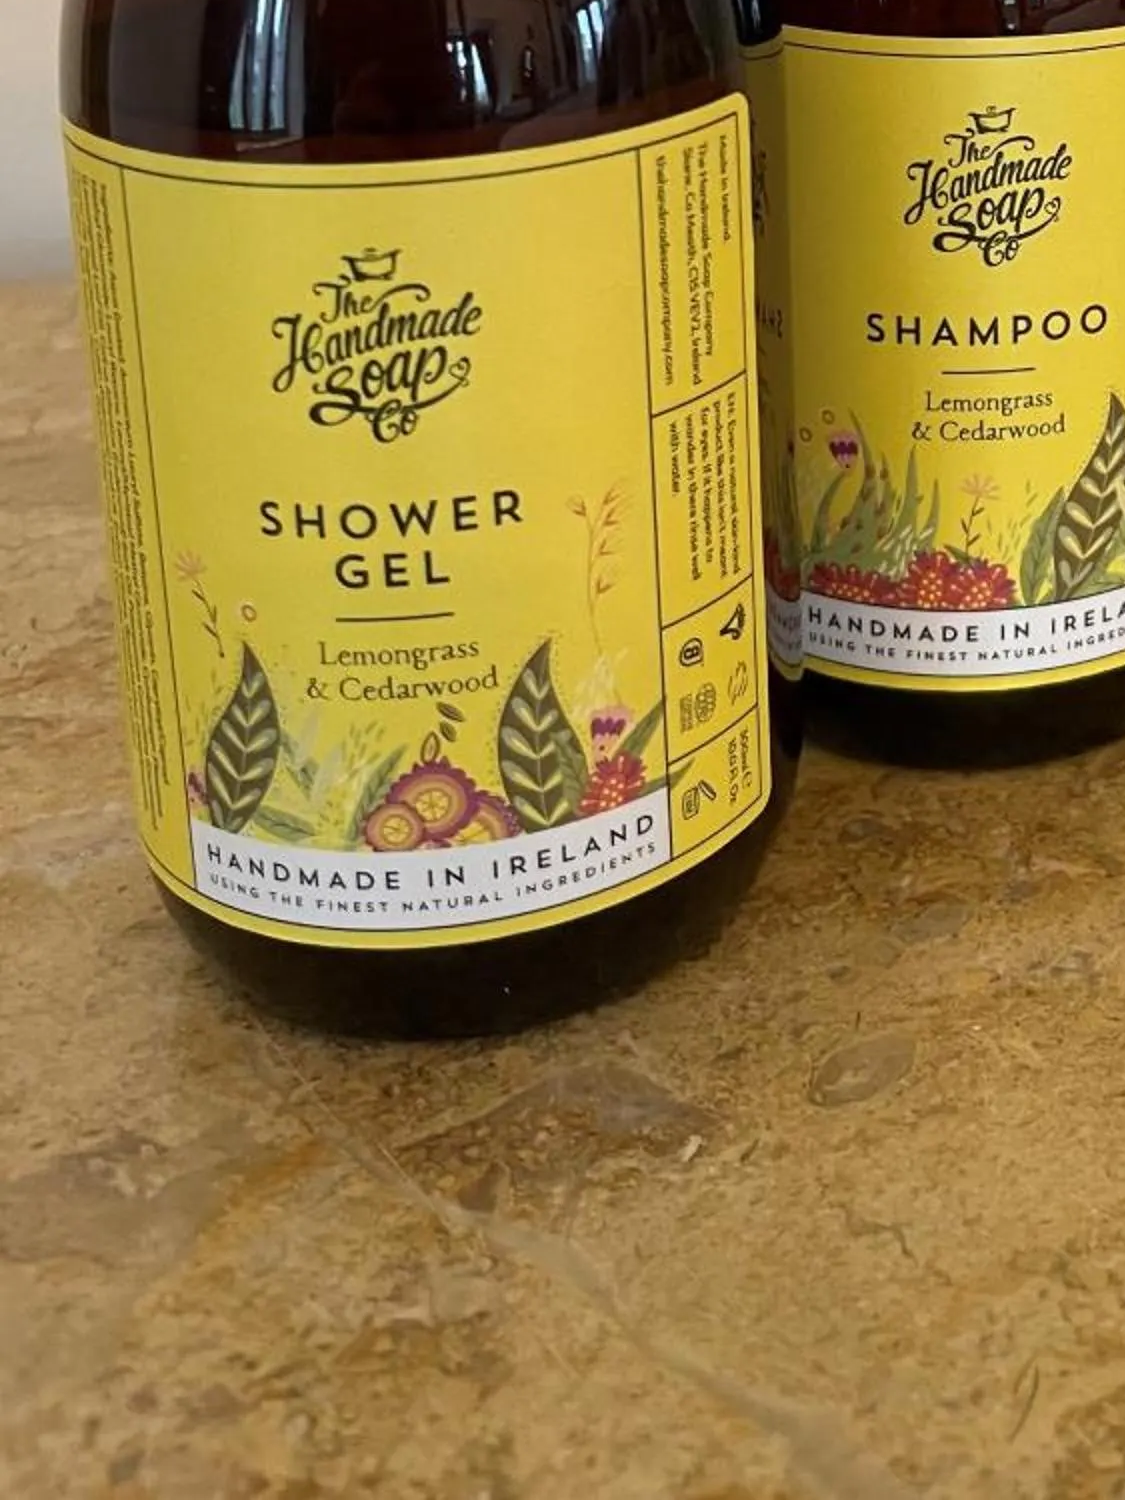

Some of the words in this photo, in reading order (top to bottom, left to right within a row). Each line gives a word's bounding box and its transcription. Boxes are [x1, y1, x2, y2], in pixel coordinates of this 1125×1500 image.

[943, 128, 1035, 168] The
[904, 143, 1072, 225] Handmade
[932, 187, 1058, 252] Soap
[977, 230, 1020, 267] Co
[312, 274, 430, 323] The
[272, 292, 483, 393] Handmade
[866, 303, 1107, 346] SHAMPOO
[309, 346, 466, 426] Soap
[925, 390, 1054, 416] Lemongrass
[365, 399, 418, 443] Co
[911, 421, 932, 442] &
[939, 413, 1066, 442] Cedarwood
[260, 490, 523, 539] SHOWER
[335, 550, 451, 589] GEL
[808, 606, 980, 643] HANDMADE
[1000, 622, 1030, 640] IN
[809, 631, 856, 651] USING
[866, 643, 895, 657] THE
[907, 650, 967, 661] FINEST
[978, 643, 1057, 660] NATURAL
[318, 641, 480, 670] Lemongrass
[306, 677, 328, 700] &
[339, 664, 498, 700] Cedarwood
[207, 844, 401, 890] HANDMADE
[428, 866, 465, 887] IN
[493, 815, 654, 879] IRELAND
[210, 873, 260, 899] USING
[269, 891, 303, 907] THE
[316, 900, 388, 913] FINEST
[402, 892, 503, 912] NATURAL
[516, 842, 655, 897] INGREDIENTS
